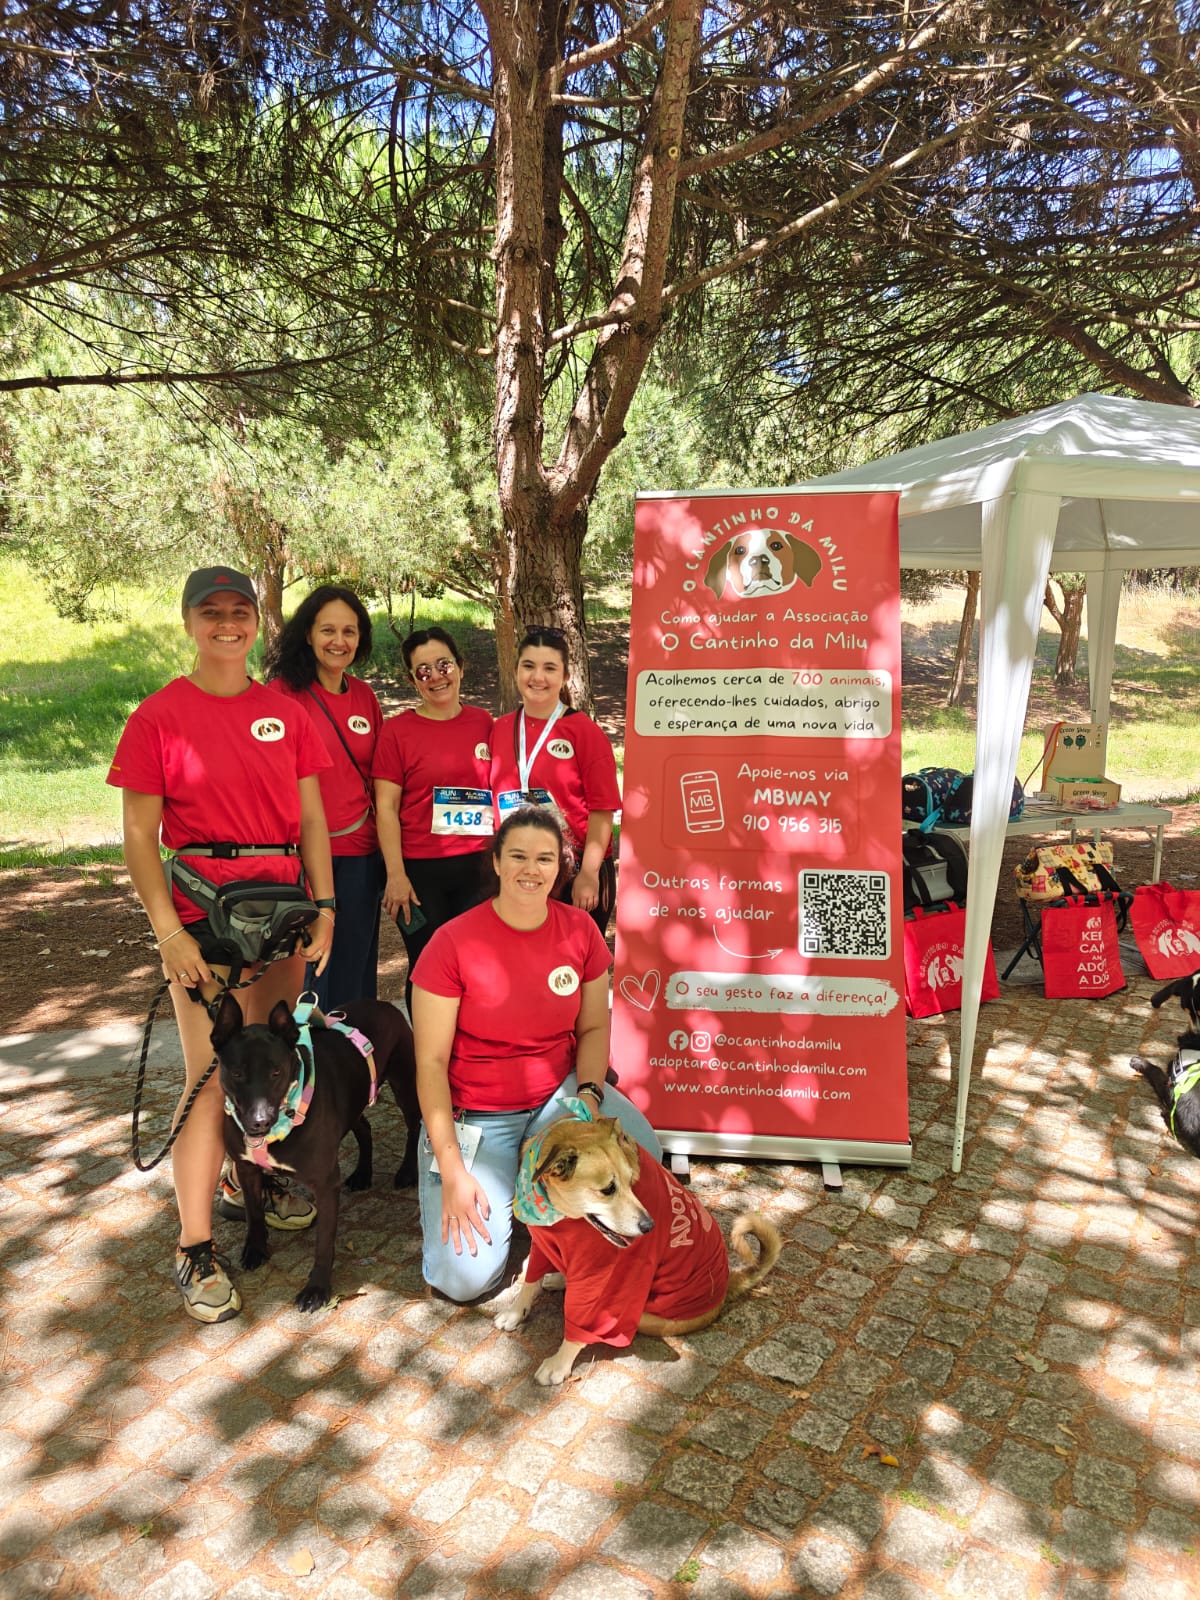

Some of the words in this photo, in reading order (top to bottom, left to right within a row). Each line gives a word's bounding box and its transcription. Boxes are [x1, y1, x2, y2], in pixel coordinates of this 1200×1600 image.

[788, 512, 814, 532] DA
[686, 506, 778, 570] CANTINHO
[818, 536, 848, 592] MILU
[683, 580, 696, 592] O
[660, 610, 700, 625] Como
[708, 610, 757, 627] ajudar
[766, 612, 775, 622] a
[783, 608, 868, 625] Associação
[661, 633, 679, 651] O
[690, 632, 779, 650] Cantinho
[790, 632, 813, 649] da
[825, 632, 868, 650] Milu
[646, 672, 716, 687] Acolhemos
[723, 674, 762, 685] cerca
[769, 672, 784, 685] de
[792, 672, 823, 686] 700
[830, 676, 886, 688] animais,
[650, 695, 757, 708] oferecendo-lhes
[764, 696, 828, 709] cuidados,
[834, 698, 880, 712] abrigo
[654, 720, 661, 729] e
[668, 719, 738, 732] esperança
[744, 716, 760, 729] de
[767, 718, 796, 729] uma
[803, 720, 837, 731] nova
[844, 718, 874, 731] vida
[737, 763, 816, 782] Apoie-nos
[824, 768, 849, 781] via
[690, 794, 714, 809] MB
[754, 788, 832, 807] MBWAY
[443, 810, 482, 825] 1438
[742, 815, 770, 832] 910
[778, 816, 810, 833] 956
[818, 817, 842, 834] 315
[643, 870, 710, 889] Outras
[719, 876, 783, 893] formas
[648, 900, 669, 916] de
[677, 905, 706, 918] nos
[716, 904, 774, 924] ajudar
[676, 981, 690, 996] O
[696, 986, 718, 997] seu
[725, 986, 762, 1002] gesto
[770, 987, 794, 1001] faz
[800, 992, 810, 1001] a
[816, 990, 887, 1006] diferença!
[714, 1033, 842, 1051] @ocantinhodamilu
[649, 1056, 867, 1076] adoptar@ocantinhodamilu.com
[664, 1082, 851, 1100] www.ocantinhodamilu.com
